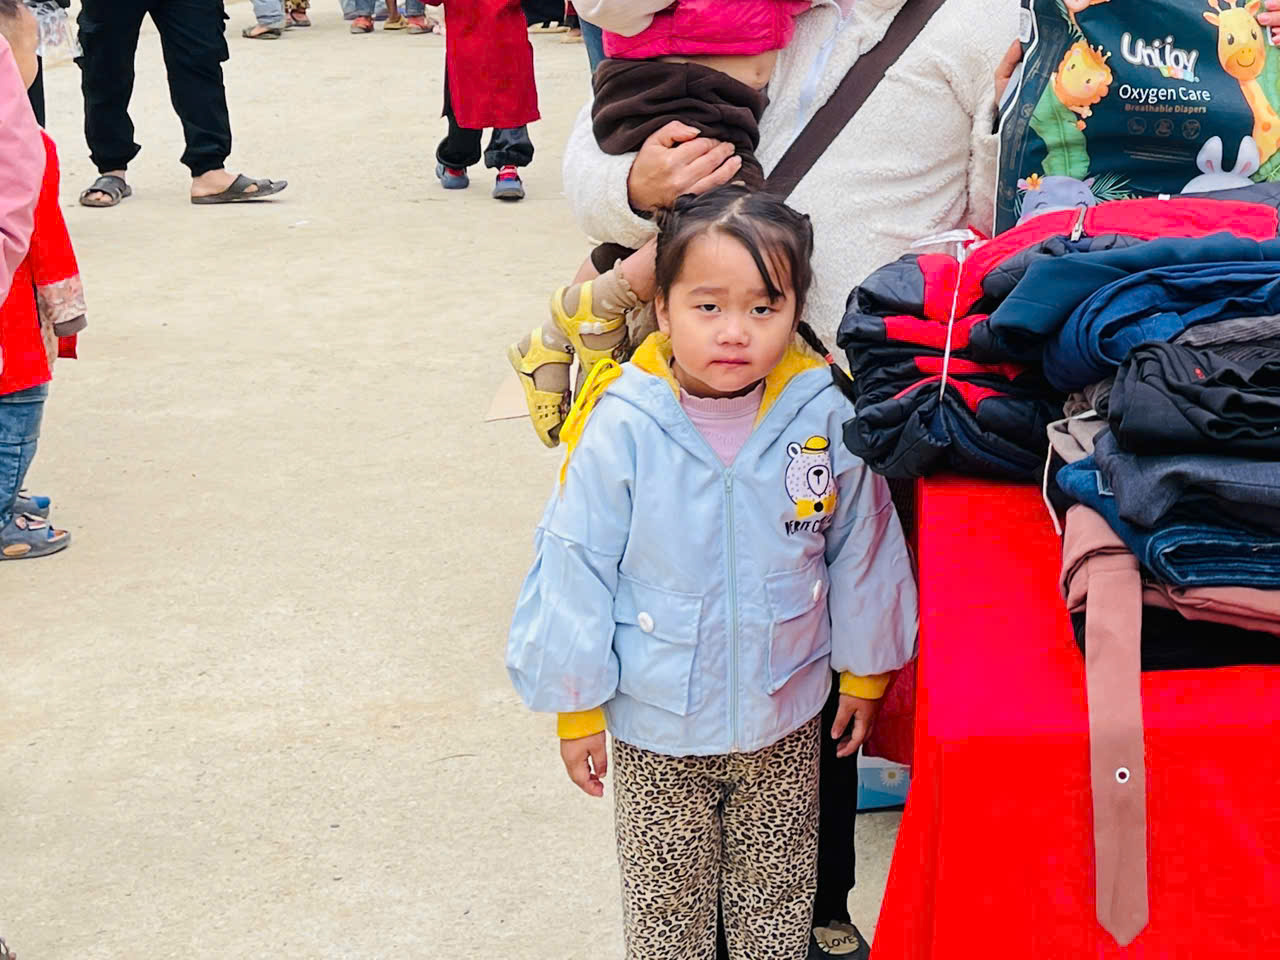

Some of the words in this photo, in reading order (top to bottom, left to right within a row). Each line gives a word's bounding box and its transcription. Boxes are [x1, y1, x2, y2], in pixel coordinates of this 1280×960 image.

[1119, 84, 1177, 104] Oxygen
[1179, 86, 1211, 101] Care
[1124, 103, 1173, 113] Breathable
[1174, 104, 1207, 115] Diapers
[824, 935, 856, 949] LOVE
